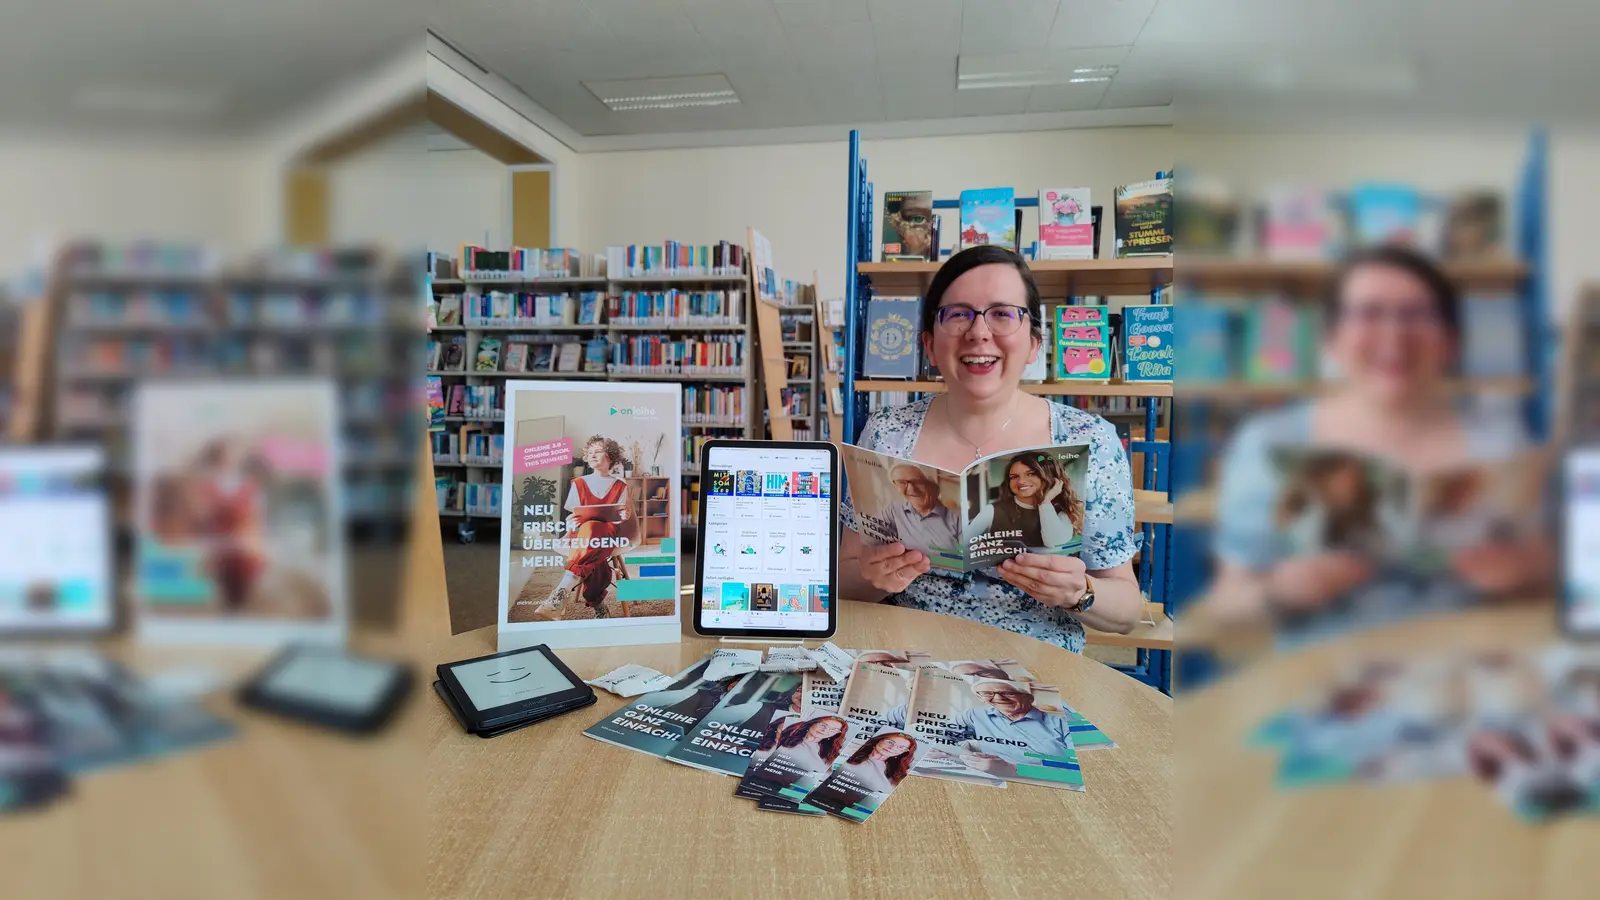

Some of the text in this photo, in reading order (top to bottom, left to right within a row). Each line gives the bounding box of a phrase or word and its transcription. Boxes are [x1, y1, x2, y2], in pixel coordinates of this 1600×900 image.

[1129, 228, 1165, 239] STUMME
[1132, 307, 1169, 322] Frank
[1137, 361, 1171, 377] Rita
[524, 451, 550, 461] COMING
[540, 454, 569, 465] SUMMER
[766, 474, 788, 489] HIM
[523, 504, 558, 516] NEU.
[523, 521, 580, 533] FRISCH.
[522, 536, 633, 550] ÜBERZEUGEND.
[969, 530, 1023, 544] ONLEIHE
[969, 540, 1004, 551] GANZ
[970, 547, 1027, 559] EINFACH!
[522, 555, 569, 567] MEHR.
[624, 710, 667, 727] GANZ
[635, 703, 698, 725] ONLEIHE
[611, 716, 682, 741] EINFACH!
[700, 728, 749, 746] GANZ
[690, 737, 755, 758] EINFAC
[773, 758, 796, 767] FRISCH
[837, 774, 860, 785] FRISCH
[827, 784, 847, 794] MEHR.
